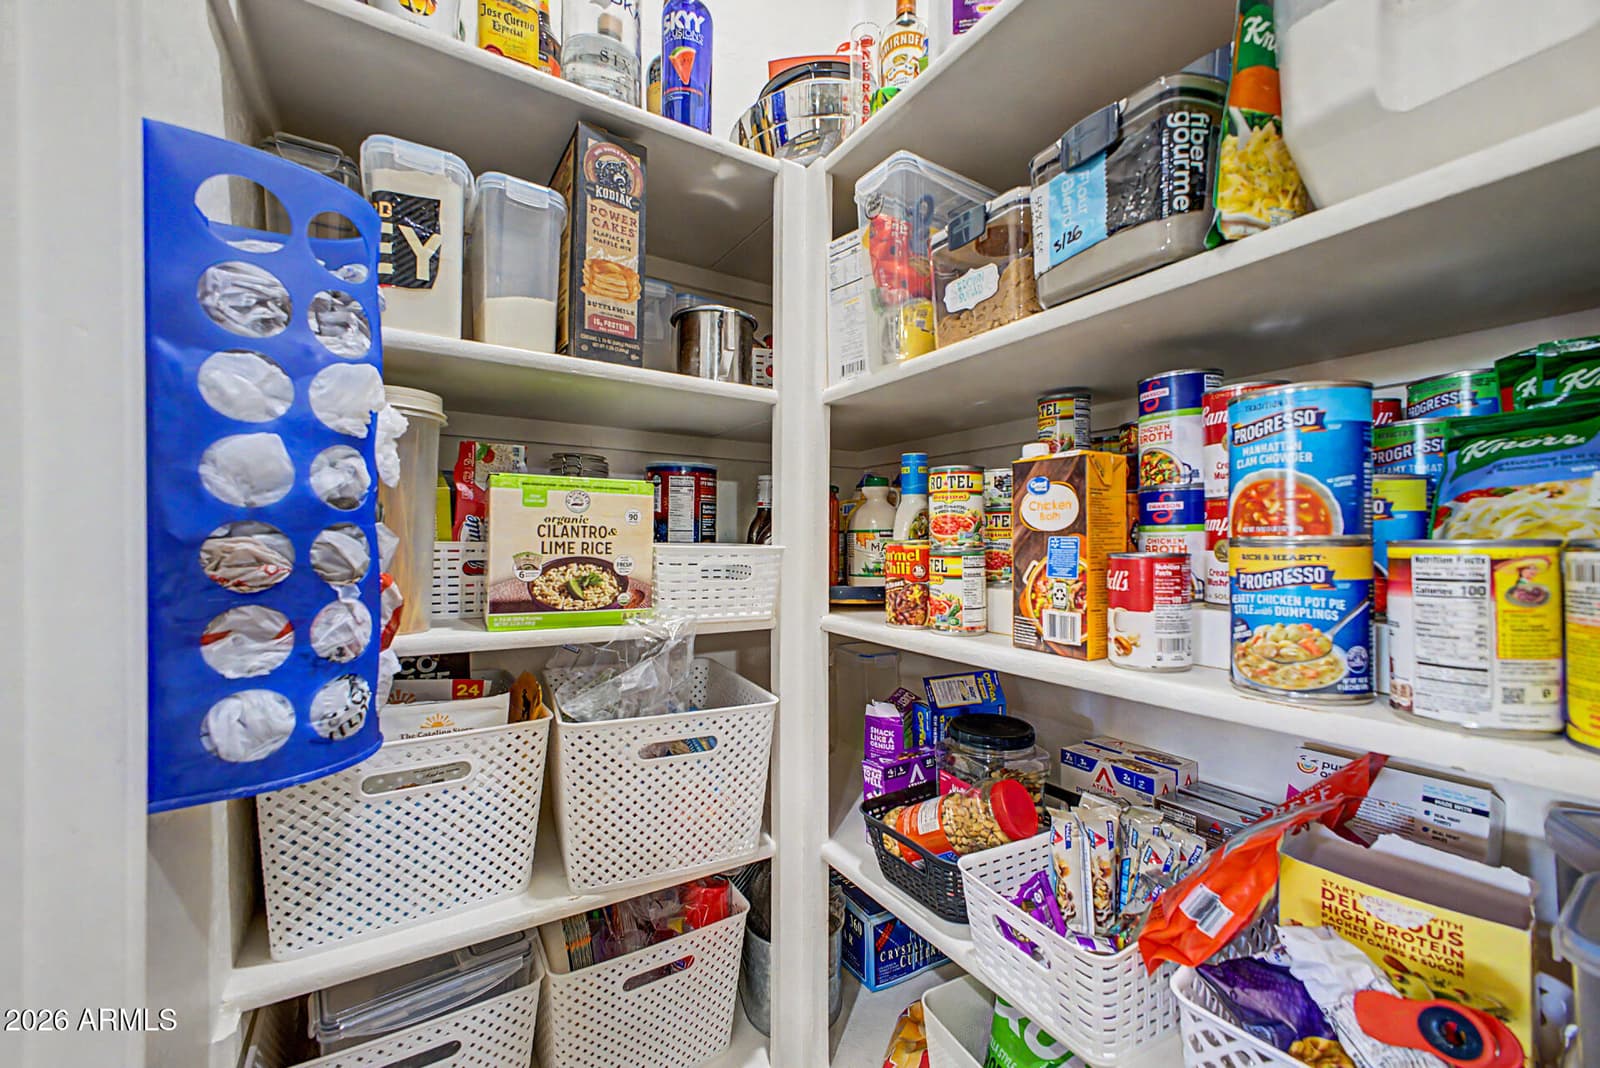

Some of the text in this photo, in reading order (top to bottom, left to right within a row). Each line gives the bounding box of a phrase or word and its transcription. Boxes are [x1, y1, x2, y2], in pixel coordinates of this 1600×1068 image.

[481, 3, 535, 32] Jose Cuervo
[663, 10, 705, 36] SKYY
[881, 33, 925, 60] IRNOF
[1190, 112, 1210, 174] fiber
[1166, 111, 1191, 213] gourme
[595, 185, 633, 210] KODIAK
[590, 204, 638, 229] POWER
[592, 217, 636, 238] CAKES
[1558, 367, 1600, 394] K
[1233, 409, 1317, 444] PROGRESSO
[1371, 438, 1445, 465] PROGRSS
[1461, 432, 1586, 465] Knorr
[1236, 457, 1258, 469] CLAM
[947, 475, 974, 490] TEL
[628, 513, 639, 521] 90
[1029, 500, 1072, 511] Chicken
[537, 524, 608, 539] CILANTRO
[543, 514, 590, 526] organic
[541, 541, 613, 555] LIME RICE
[1147, 538, 1185, 546] CHICKEN
[1273, 553, 1326, 561] HEARTY
[1239, 566, 1326, 591] PROGRESSO
[1460, 585, 1487, 596] 100
[1257, 594, 1302, 607] CHICKEN
[1304, 596, 1326, 609] POT
[1328, 598, 1347, 611] PIE
[1274, 606, 1339, 621] DUMPLINGS
[456, 684, 480, 696] 24
[1322, 879, 1355, 897] START
[1321, 886, 1465, 947] DELUS
[1321, 900, 1465, 960] HIGH PROTEIN
[1321, 911, 1465, 970] PACKED WITH FLAVOR
[1344, 926, 1364, 942] NET
[1367, 936, 1406, 958] CARBS
[1420, 958, 1465, 979] SUGAR
